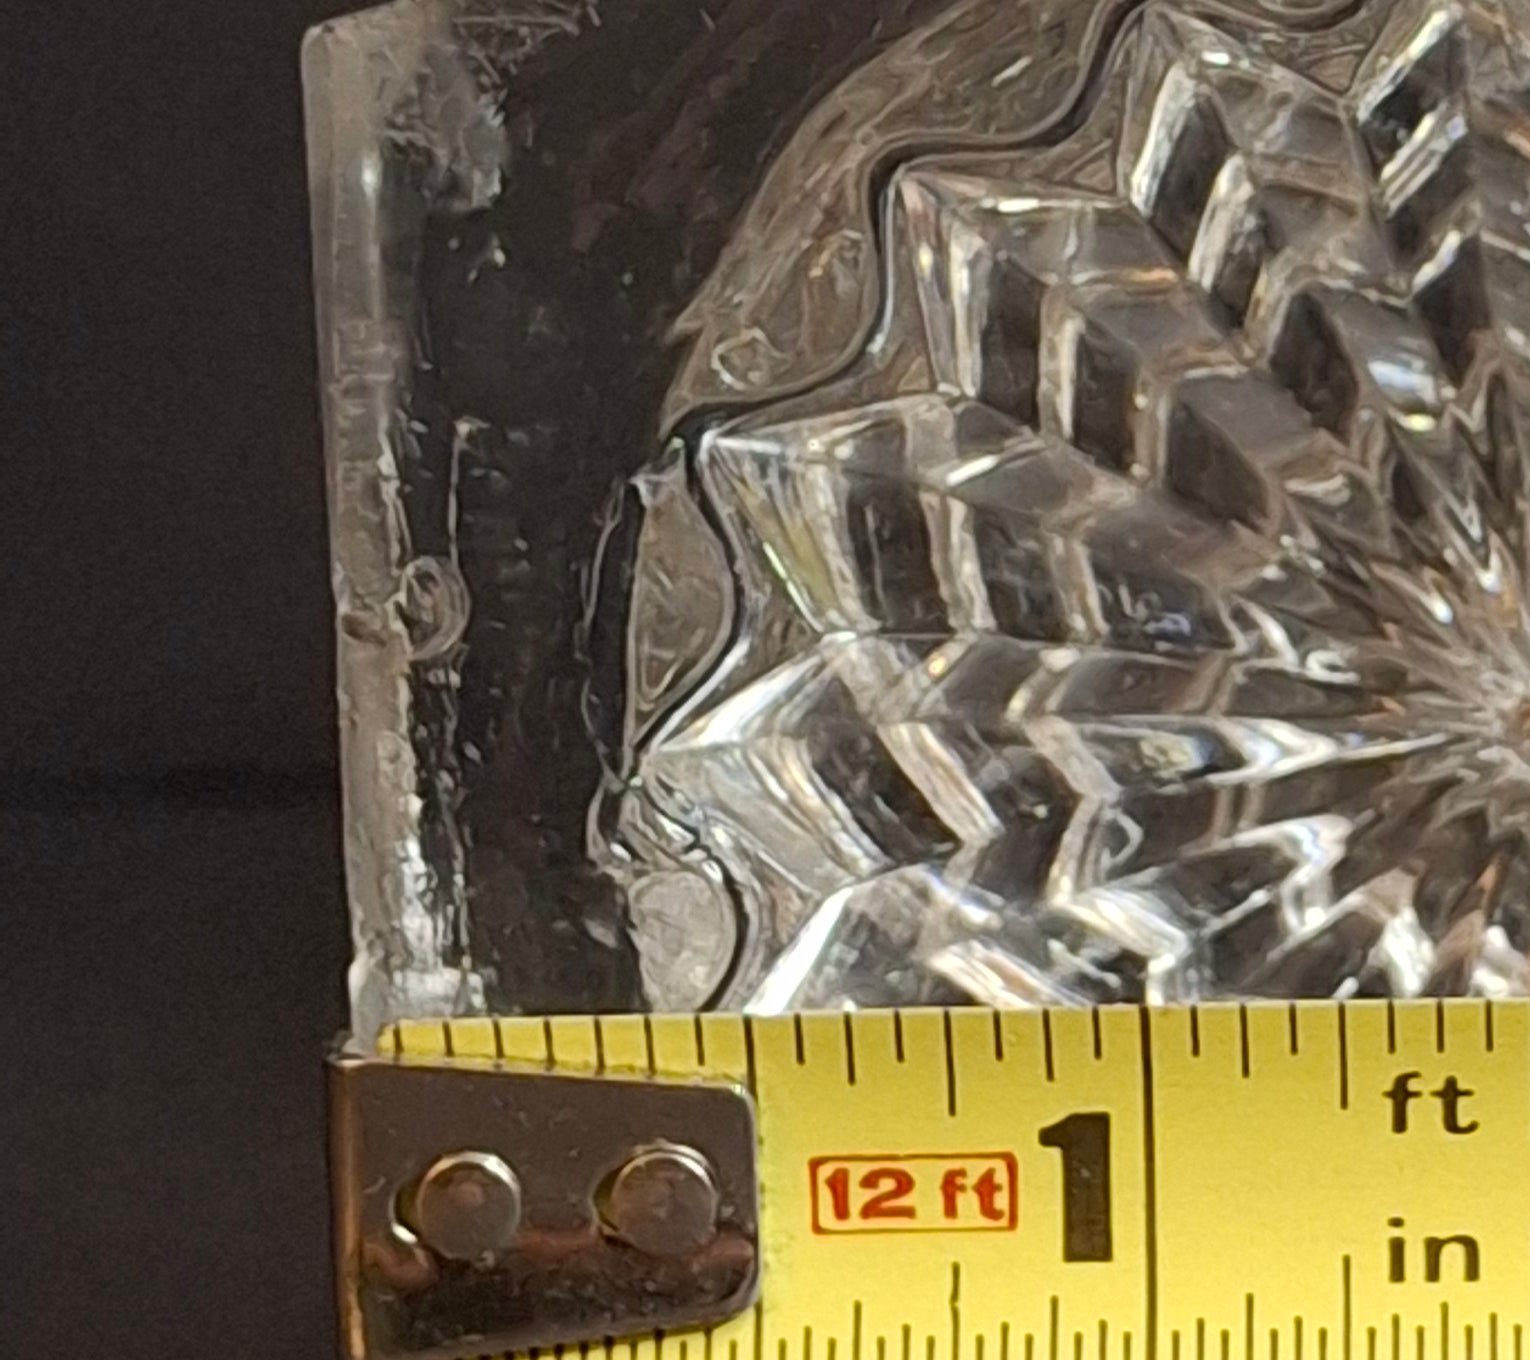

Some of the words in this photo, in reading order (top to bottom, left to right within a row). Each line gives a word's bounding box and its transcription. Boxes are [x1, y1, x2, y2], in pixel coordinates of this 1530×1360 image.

[1382, 1071, 1480, 1135] ft
[822, 1167, 916, 1222] 12
[939, 1167, 1006, 1222] ft
[1038, 1111, 1113, 1263] 1
[1387, 1216, 1481, 1283] in
